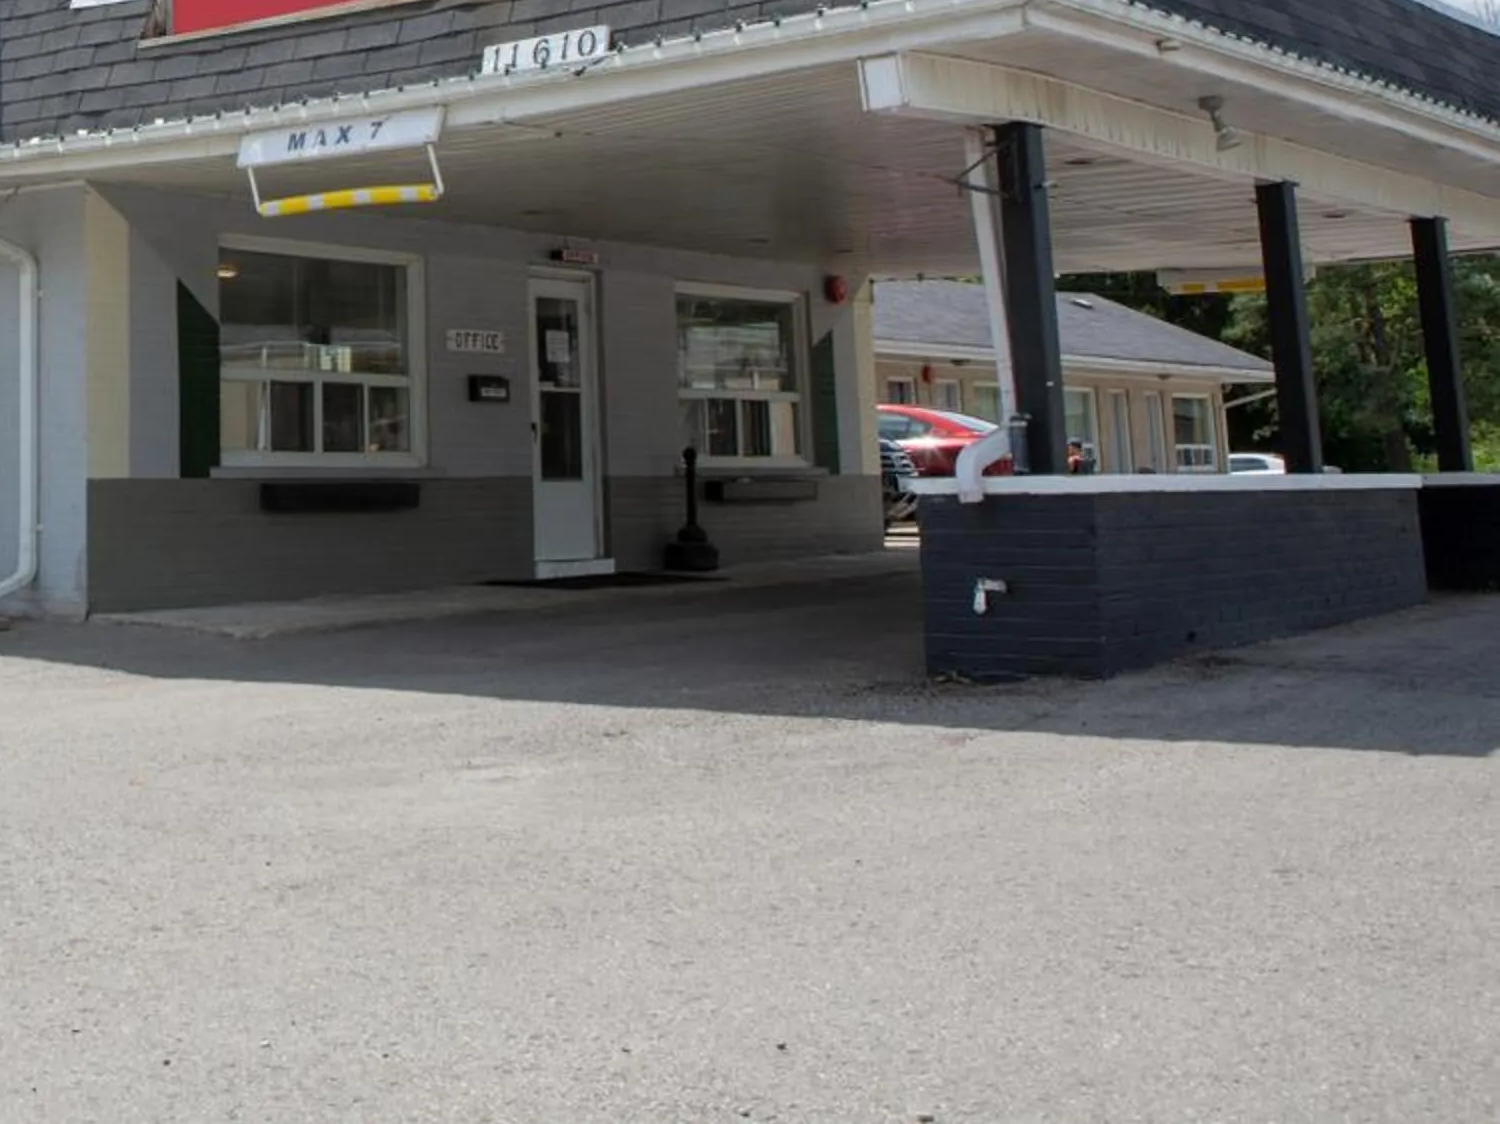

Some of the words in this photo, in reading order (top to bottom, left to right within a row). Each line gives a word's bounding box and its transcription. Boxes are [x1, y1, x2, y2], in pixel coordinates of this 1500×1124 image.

[493, 29, 597, 72] 11610
[288, 125, 353, 152] MAX
[370, 121, 384, 141] 7
[455, 332, 500, 350] OFFICE
